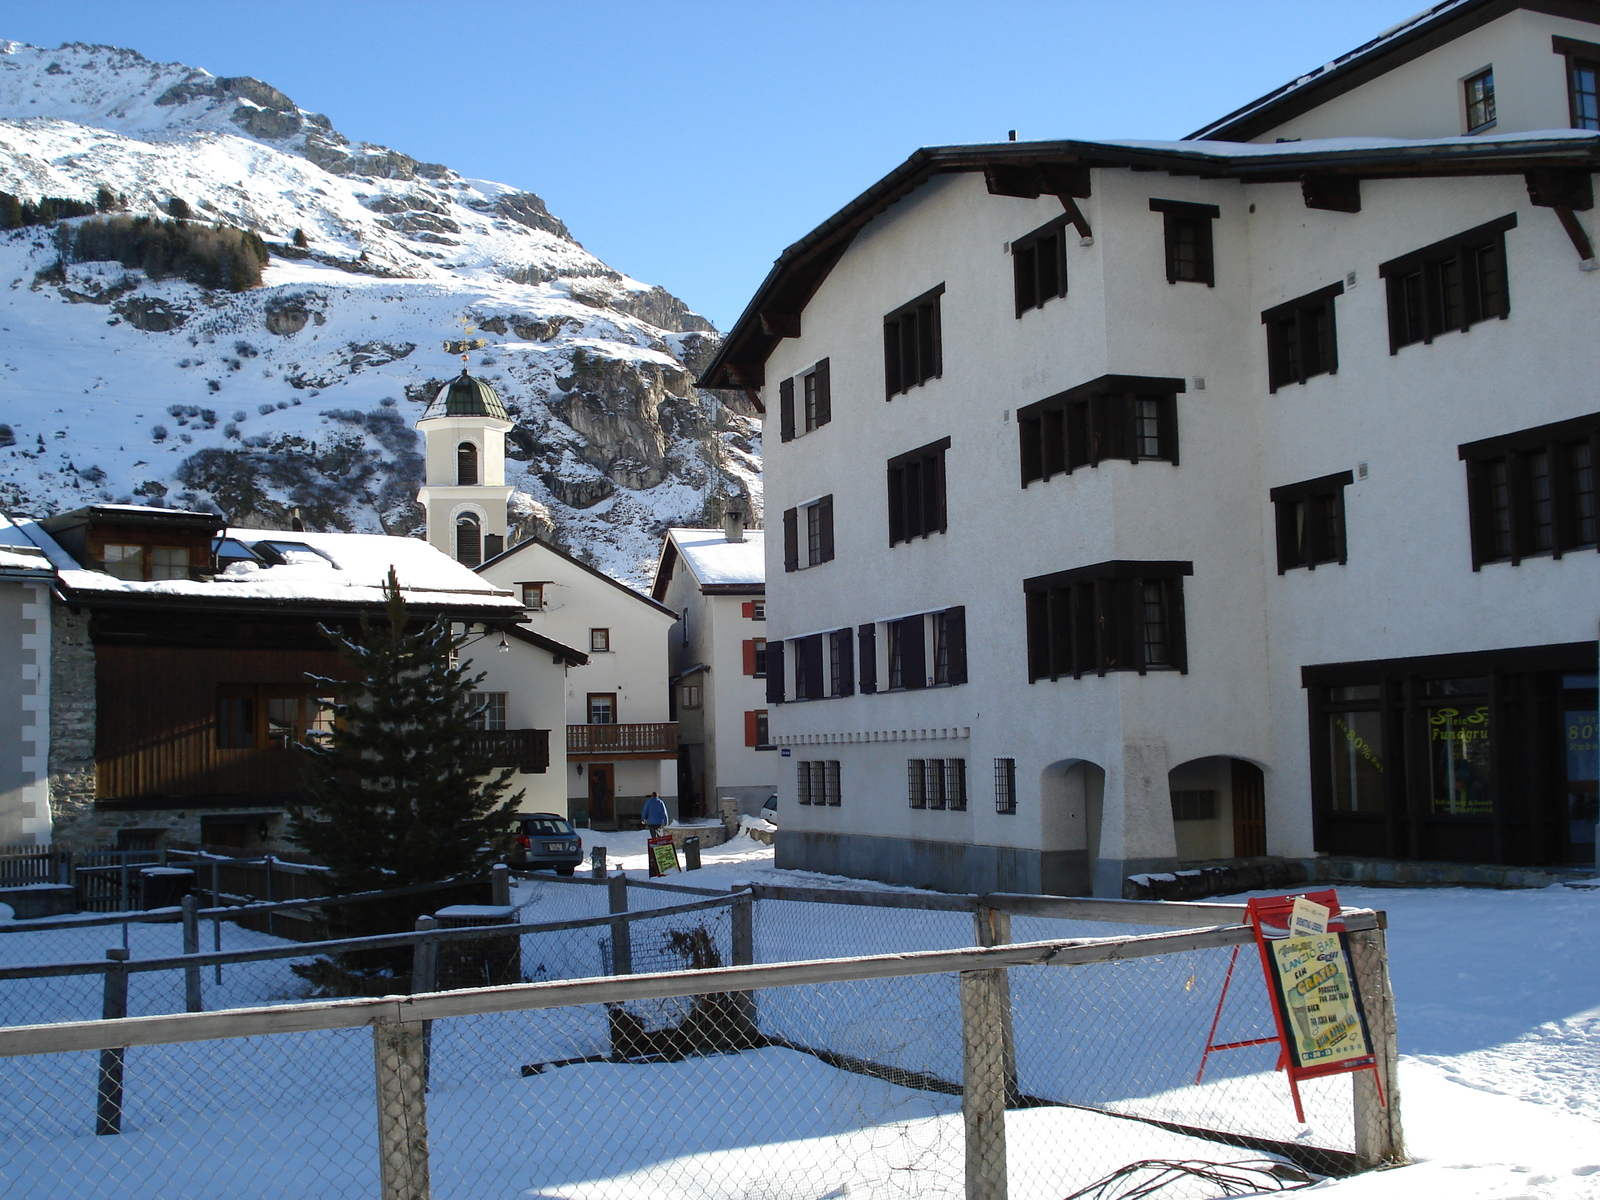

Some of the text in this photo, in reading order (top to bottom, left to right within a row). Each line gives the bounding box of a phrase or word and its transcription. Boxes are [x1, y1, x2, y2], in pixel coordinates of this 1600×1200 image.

[1346, 730, 1372, 759] 80%
[1282, 949, 1316, 974] LANZIO
[1317, 938, 1337, 953] BAR
[1316, 951, 1338, 962] Grill
[1294, 967, 1308, 980] EIN
[1297, 963, 1338, 995] GRATIS
[1307, 1003, 1320, 1013] BIER
